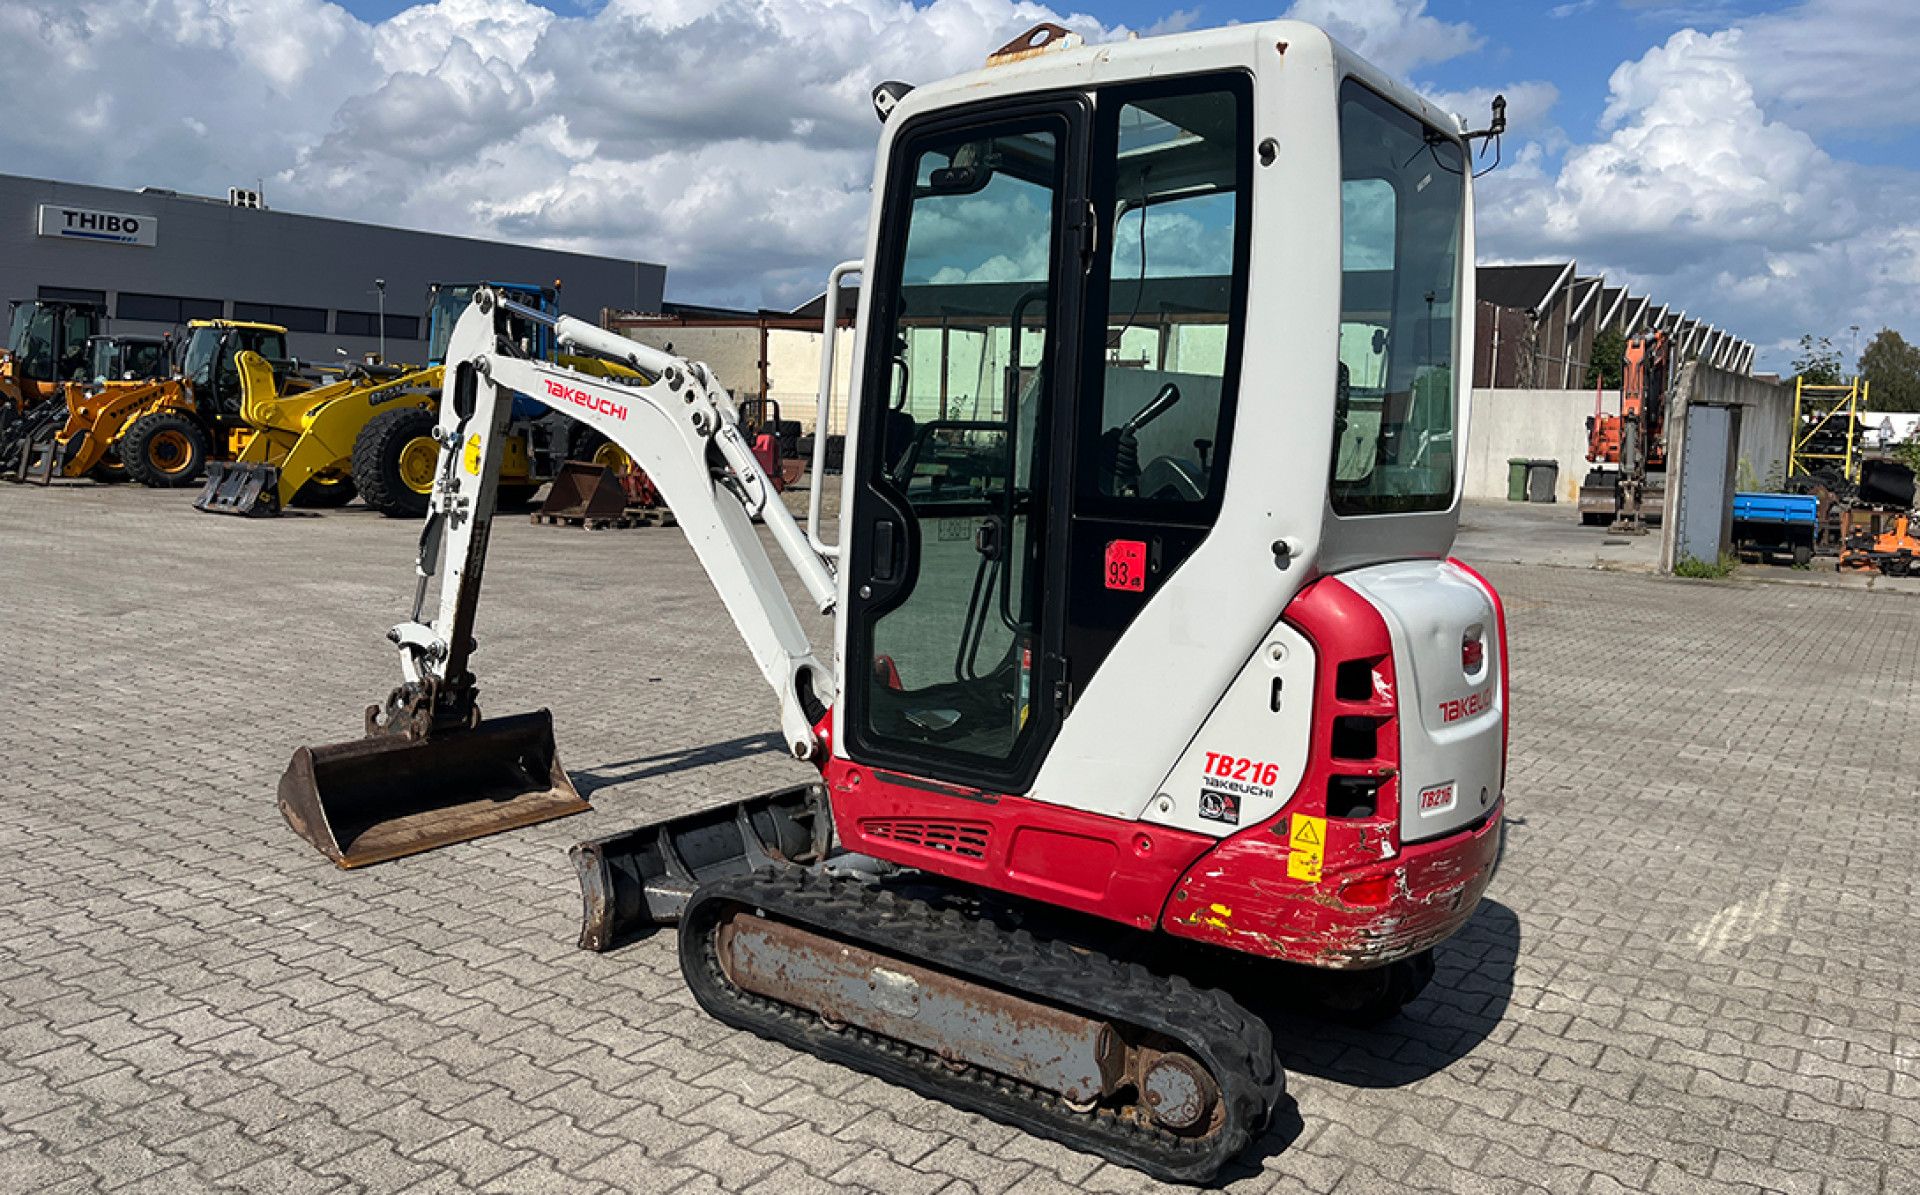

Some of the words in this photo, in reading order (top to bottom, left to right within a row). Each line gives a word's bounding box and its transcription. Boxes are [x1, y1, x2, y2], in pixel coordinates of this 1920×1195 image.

[63, 211, 139, 234] THIBO
[545, 379, 628, 421] TAKEUCHI
[1109, 561, 1129, 585] 93
[1204, 751, 1280, 786] TB216
[1203, 775, 1274, 798] TAKEUCHI
[1421, 786, 1452, 808] TB216
